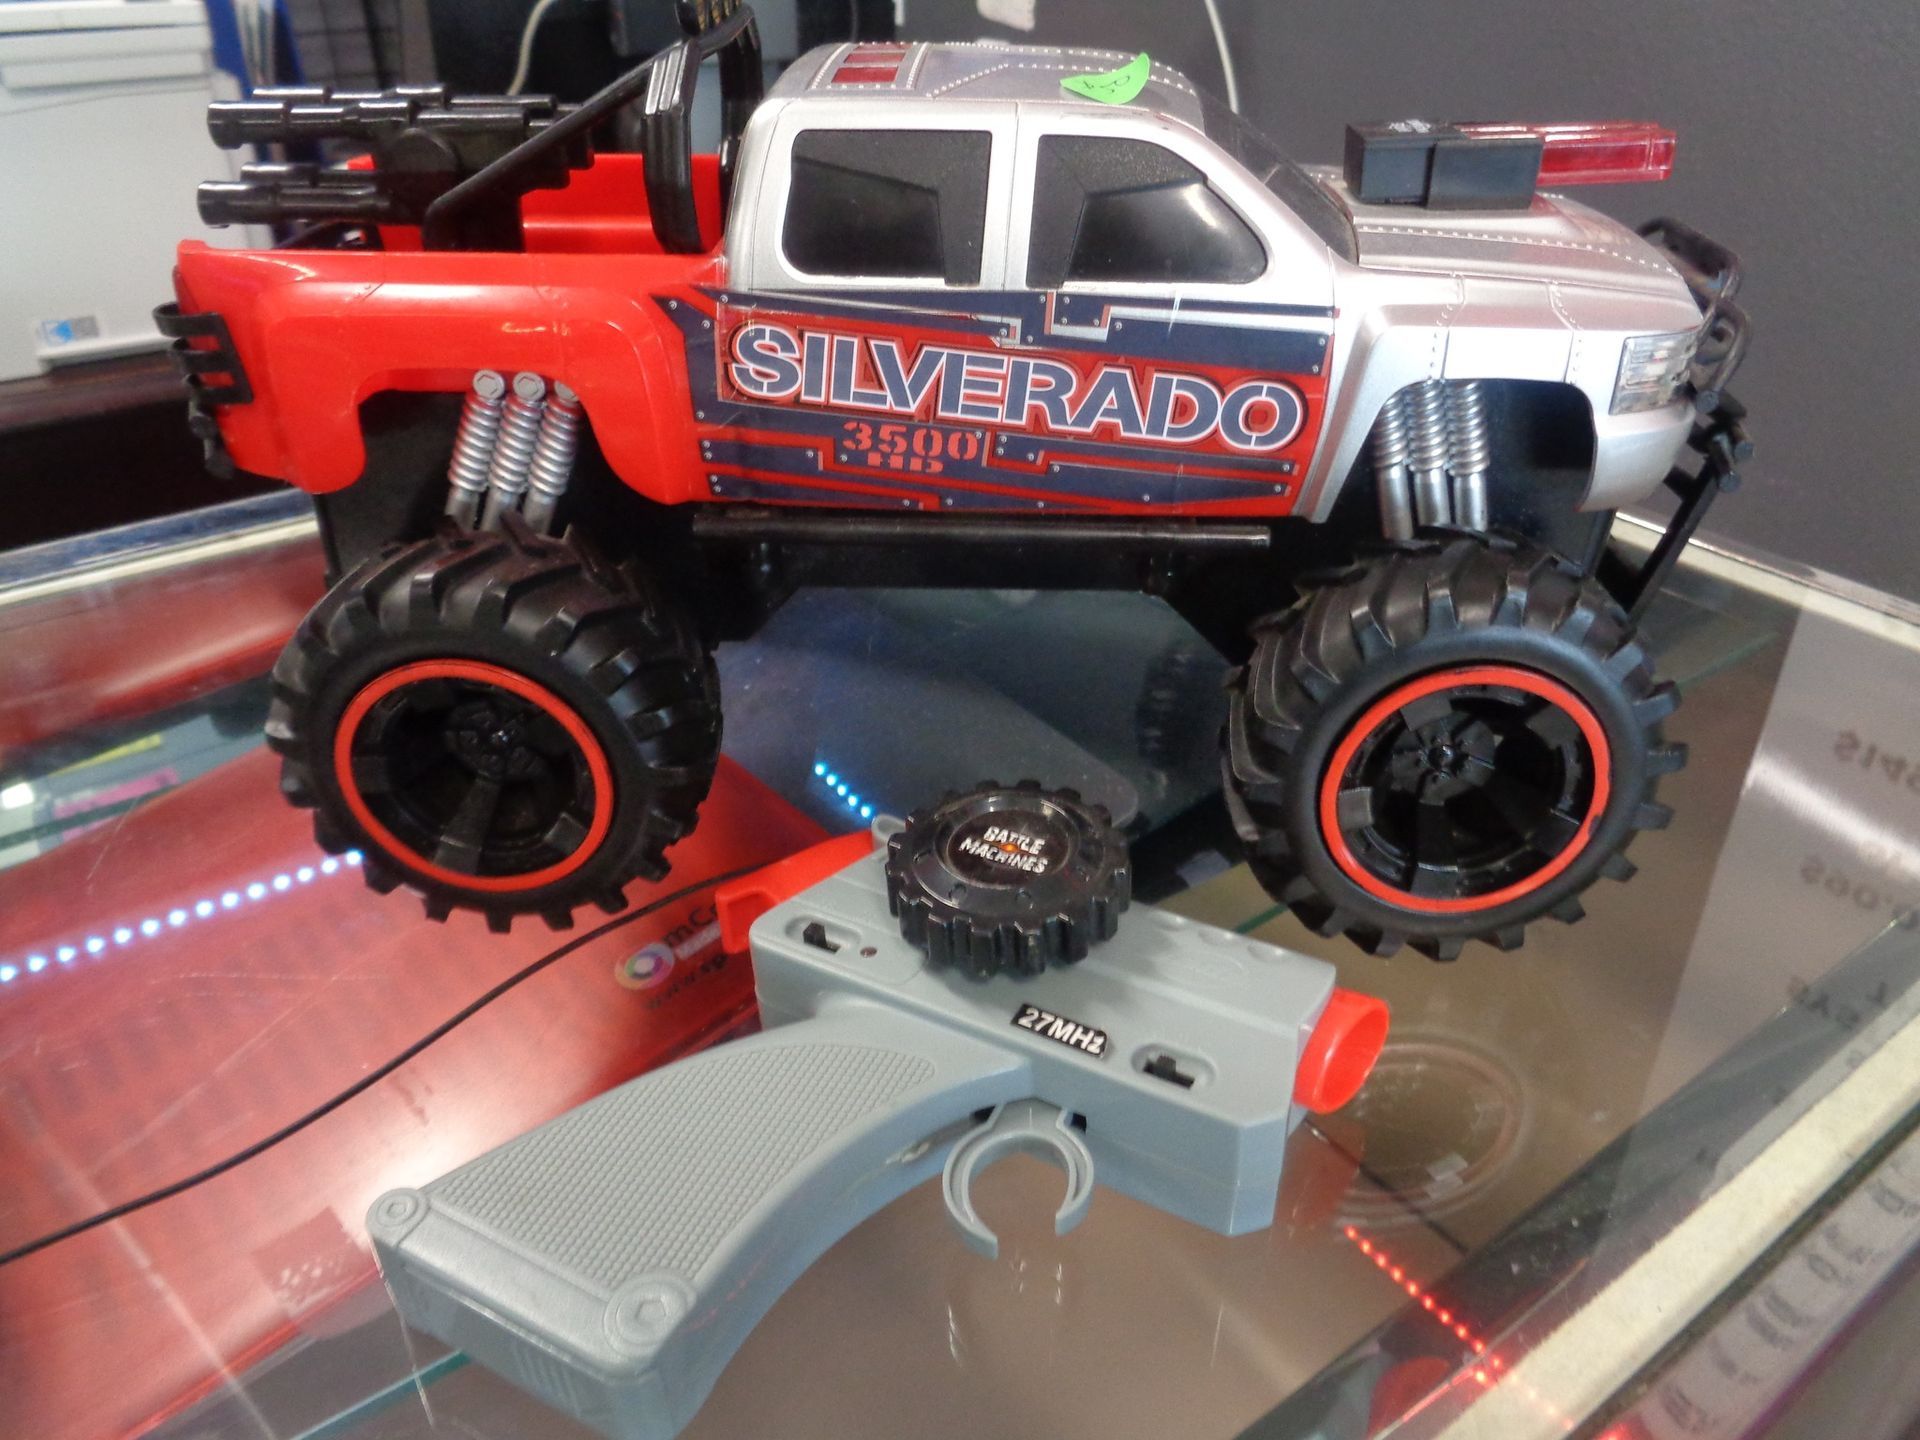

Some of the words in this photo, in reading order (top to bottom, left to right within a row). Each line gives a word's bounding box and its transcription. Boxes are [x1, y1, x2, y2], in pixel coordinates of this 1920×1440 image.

[731, 326, 1304, 452] SILVERADO
[842, 421, 978, 461] 3500
[959, 836, 1049, 874] MACHINES
[983, 825, 1046, 855] BATTLE
[1017, 1006, 1105, 1054] 27MHz
